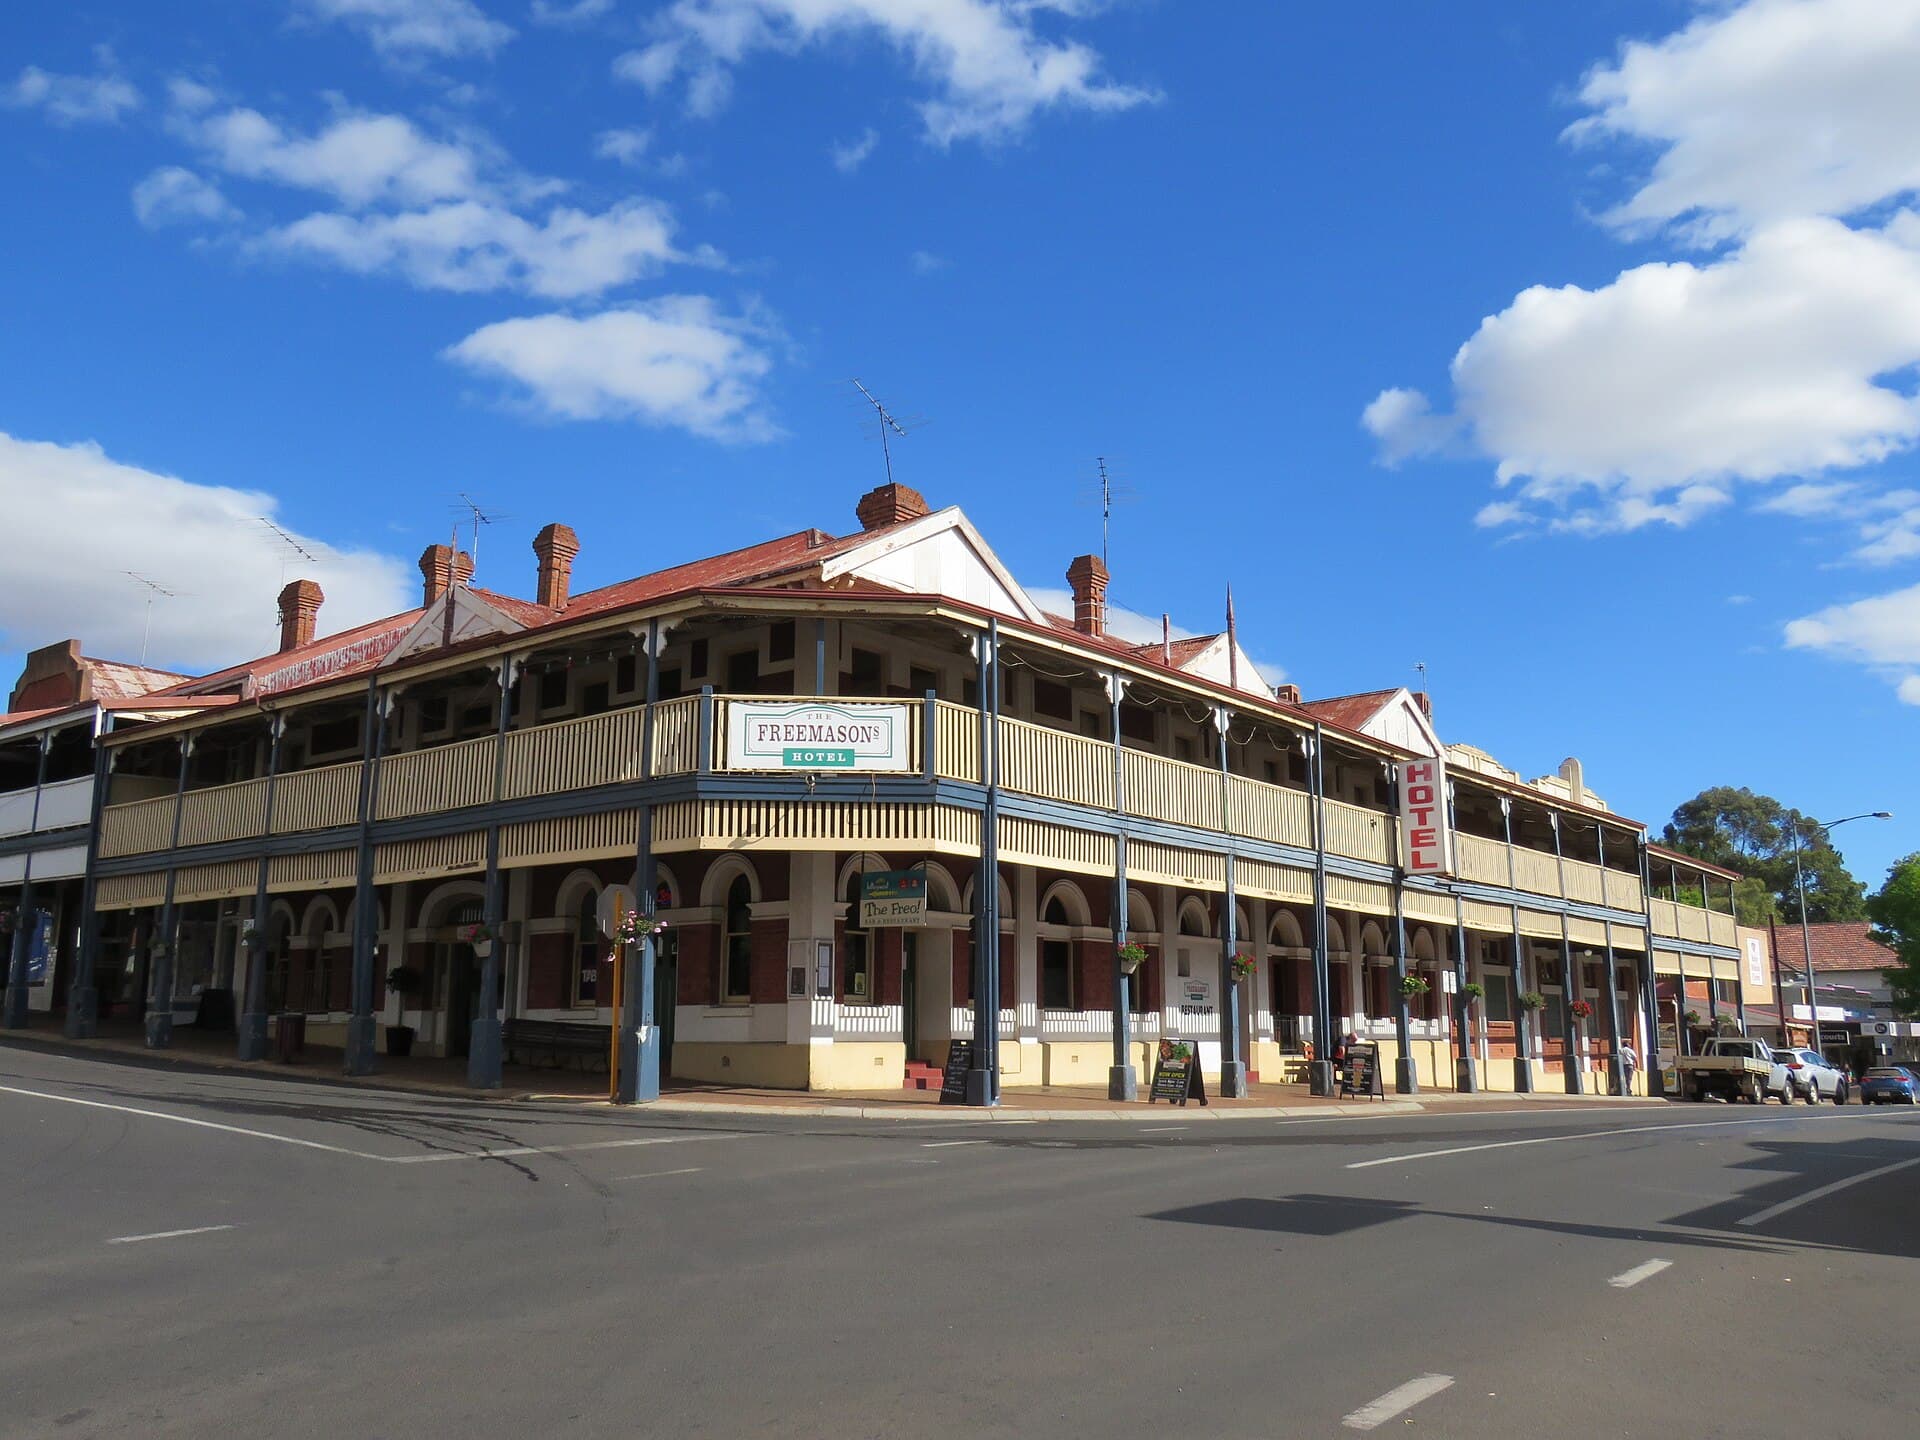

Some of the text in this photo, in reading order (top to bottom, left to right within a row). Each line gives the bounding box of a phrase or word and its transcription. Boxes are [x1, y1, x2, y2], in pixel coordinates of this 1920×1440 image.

[791, 752, 847, 762] HOTEL
[1406, 763, 1438, 869] HOTEL
[864, 899, 921, 917] The Freo!
[582, 969, 597, 982] TAB
[1180, 1004, 1213, 1017] RESTAURANT
